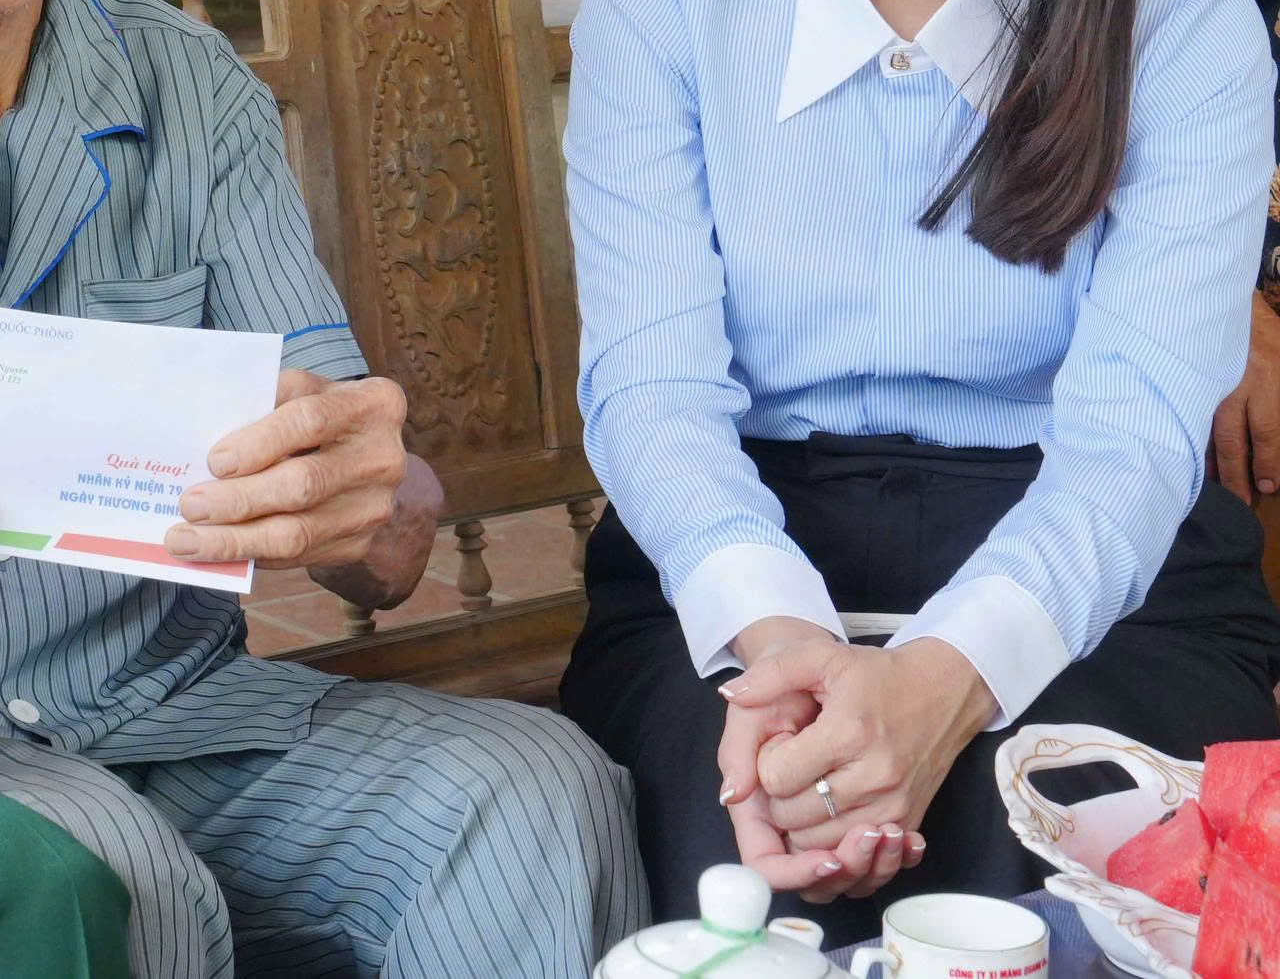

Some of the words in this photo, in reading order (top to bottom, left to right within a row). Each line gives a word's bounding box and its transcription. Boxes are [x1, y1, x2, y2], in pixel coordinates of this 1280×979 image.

[107, 453, 140, 470] Quà
[144, 459, 191, 477] tặng!
[77, 472, 112, 488] NHÂN
[115, 475, 132, 490] KỶ
[134, 478, 165, 496] NIỆM
[168, 484, 184, 496] 79
[59, 489, 95, 505] NGÀY
[98, 495, 151, 513] THƯƠNG
